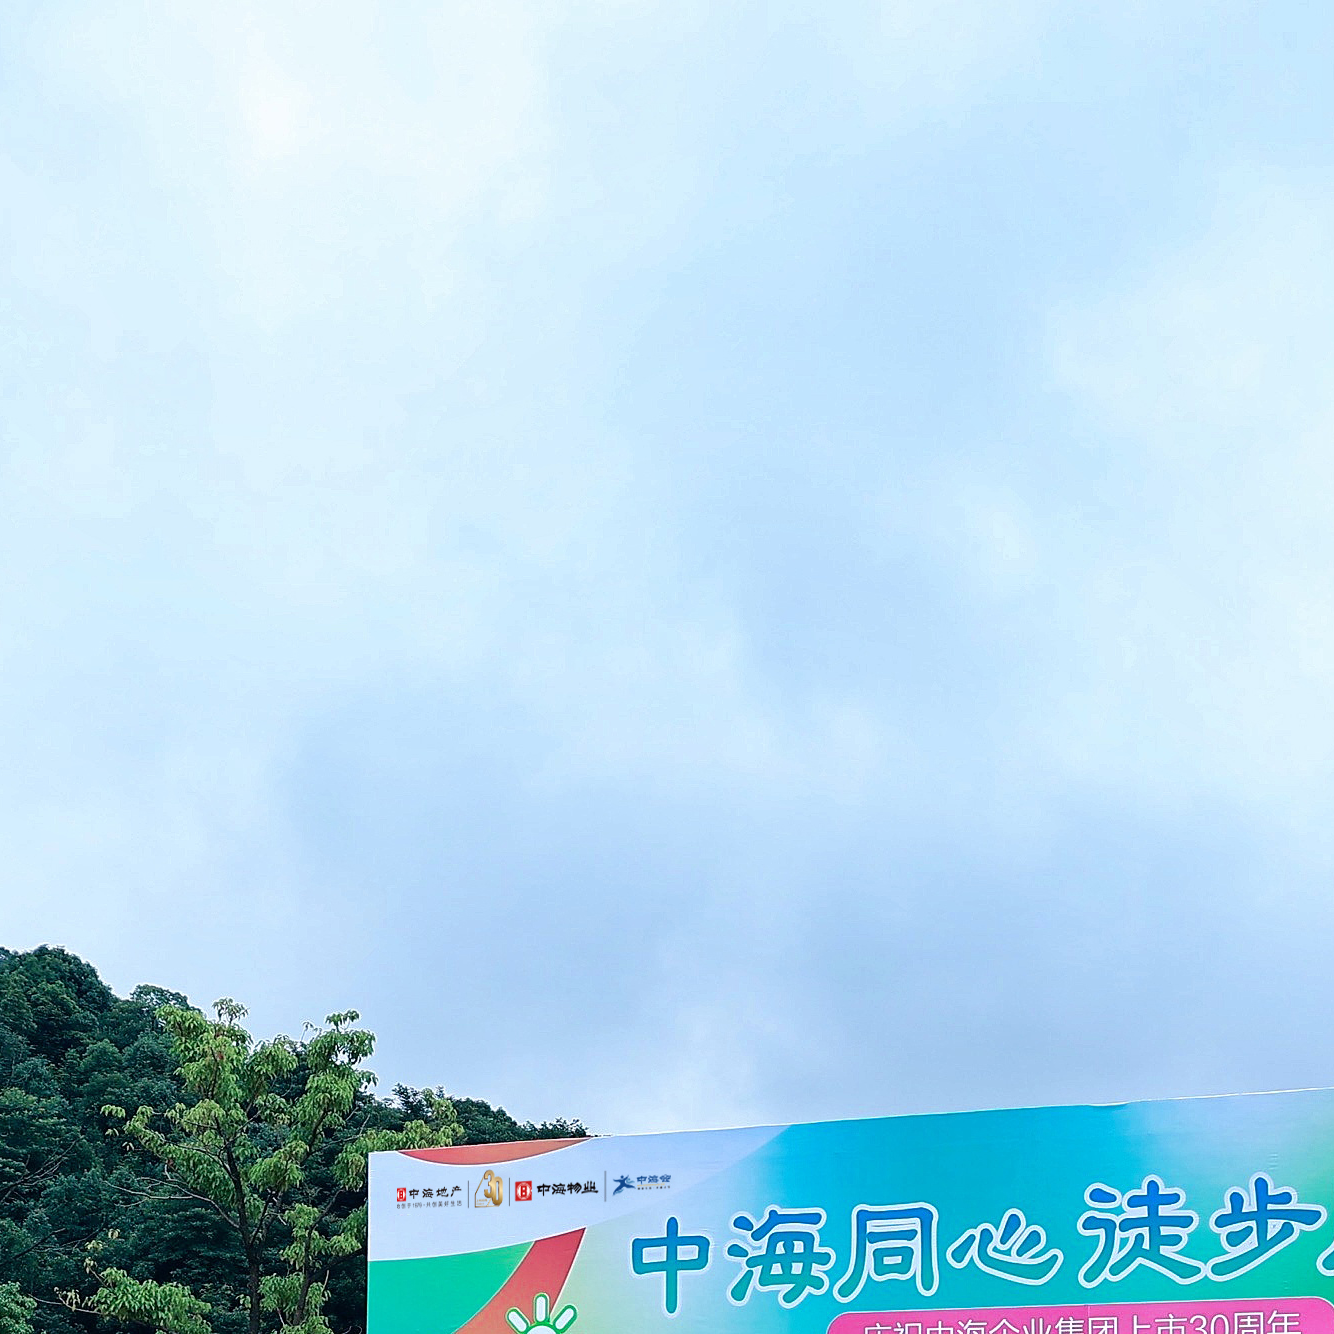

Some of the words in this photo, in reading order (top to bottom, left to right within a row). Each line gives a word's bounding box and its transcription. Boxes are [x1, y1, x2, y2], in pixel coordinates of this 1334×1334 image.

[408, 1185, 462, 1200] 中海地产
[536, 1180, 599, 1197] 中海物业
